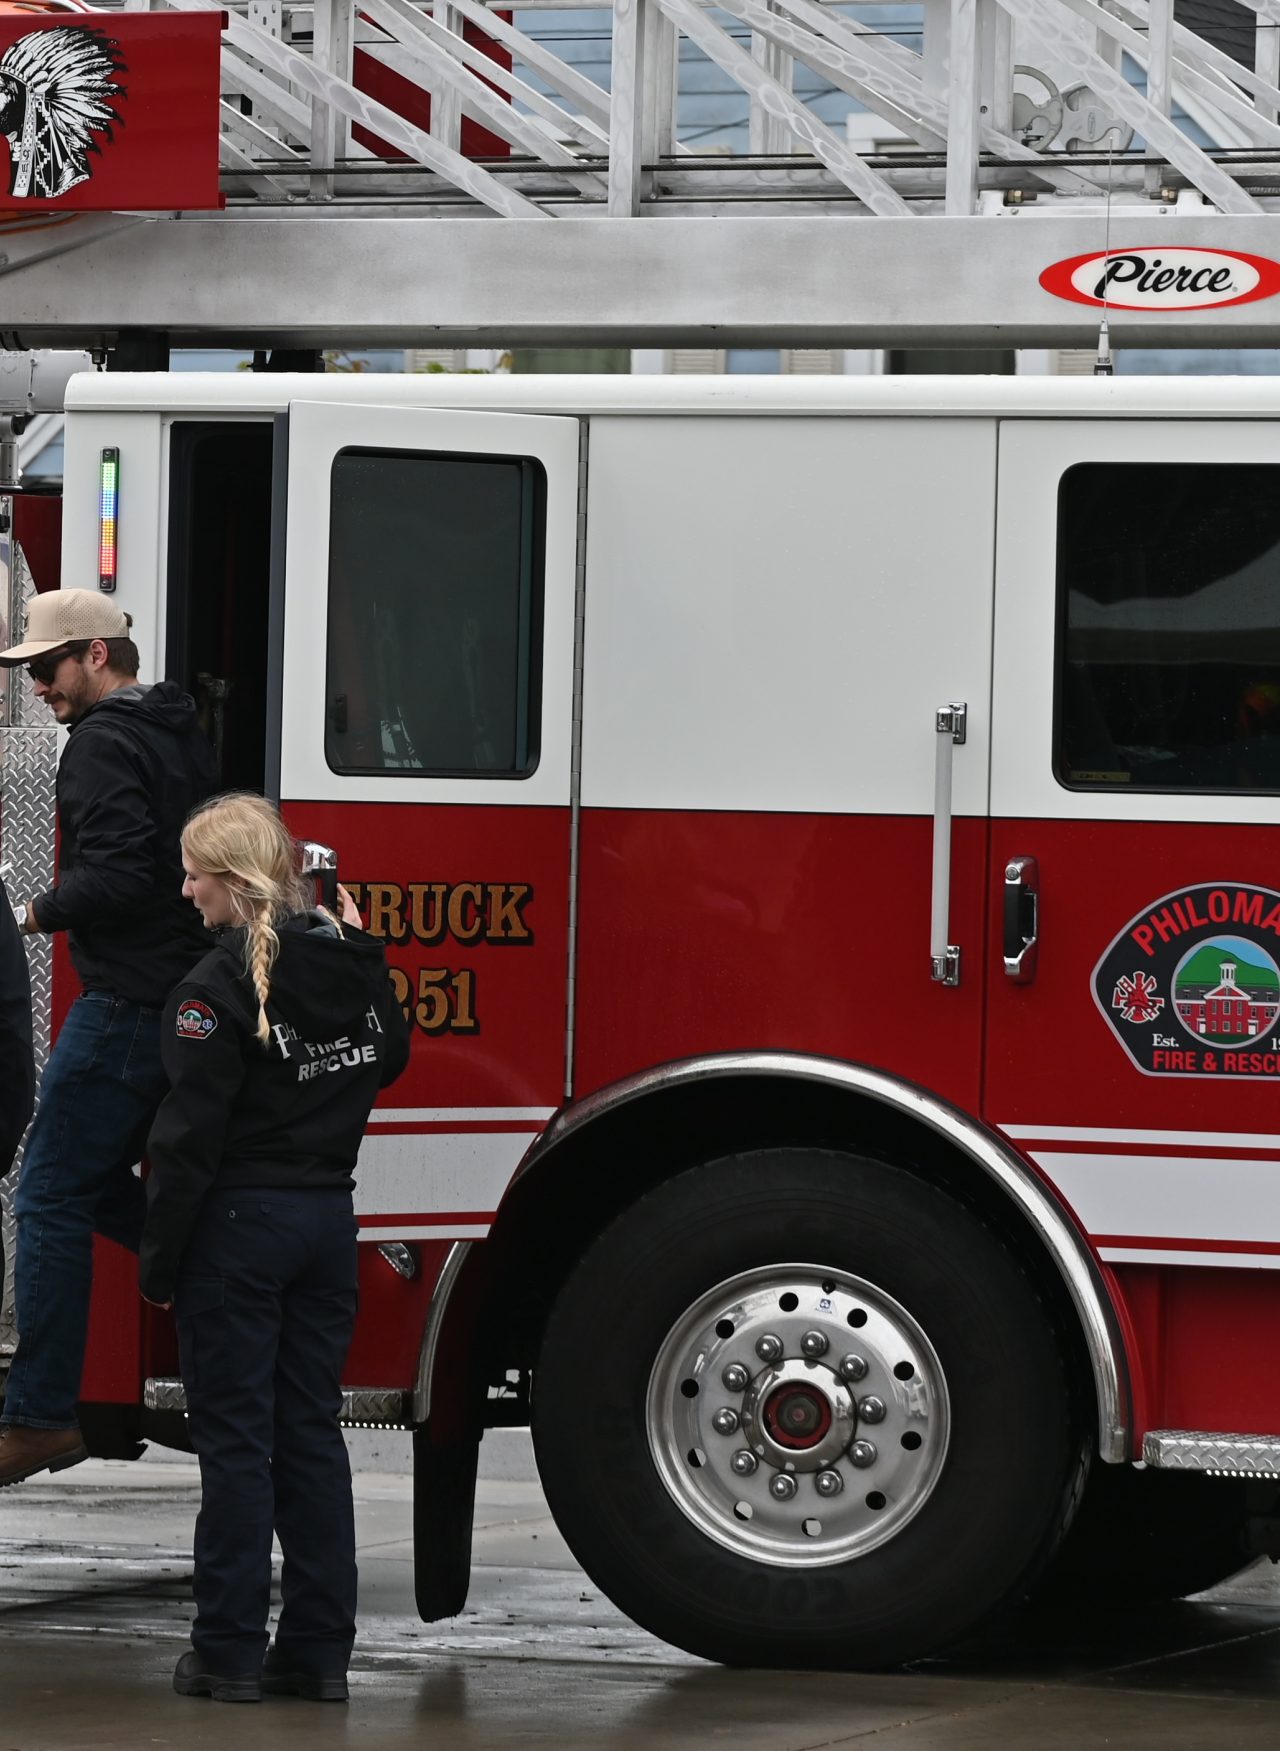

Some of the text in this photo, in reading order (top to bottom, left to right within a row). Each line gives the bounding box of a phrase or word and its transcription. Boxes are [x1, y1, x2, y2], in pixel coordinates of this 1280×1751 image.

[1094, 255, 1234, 300] Pierce
[1151, 1033, 1280, 1050] Est. 1
[297, 1044, 377, 1081] RESCUE
[1153, 1050, 1197, 1071] FIRE
[1202, 1051, 1218, 1072] &
